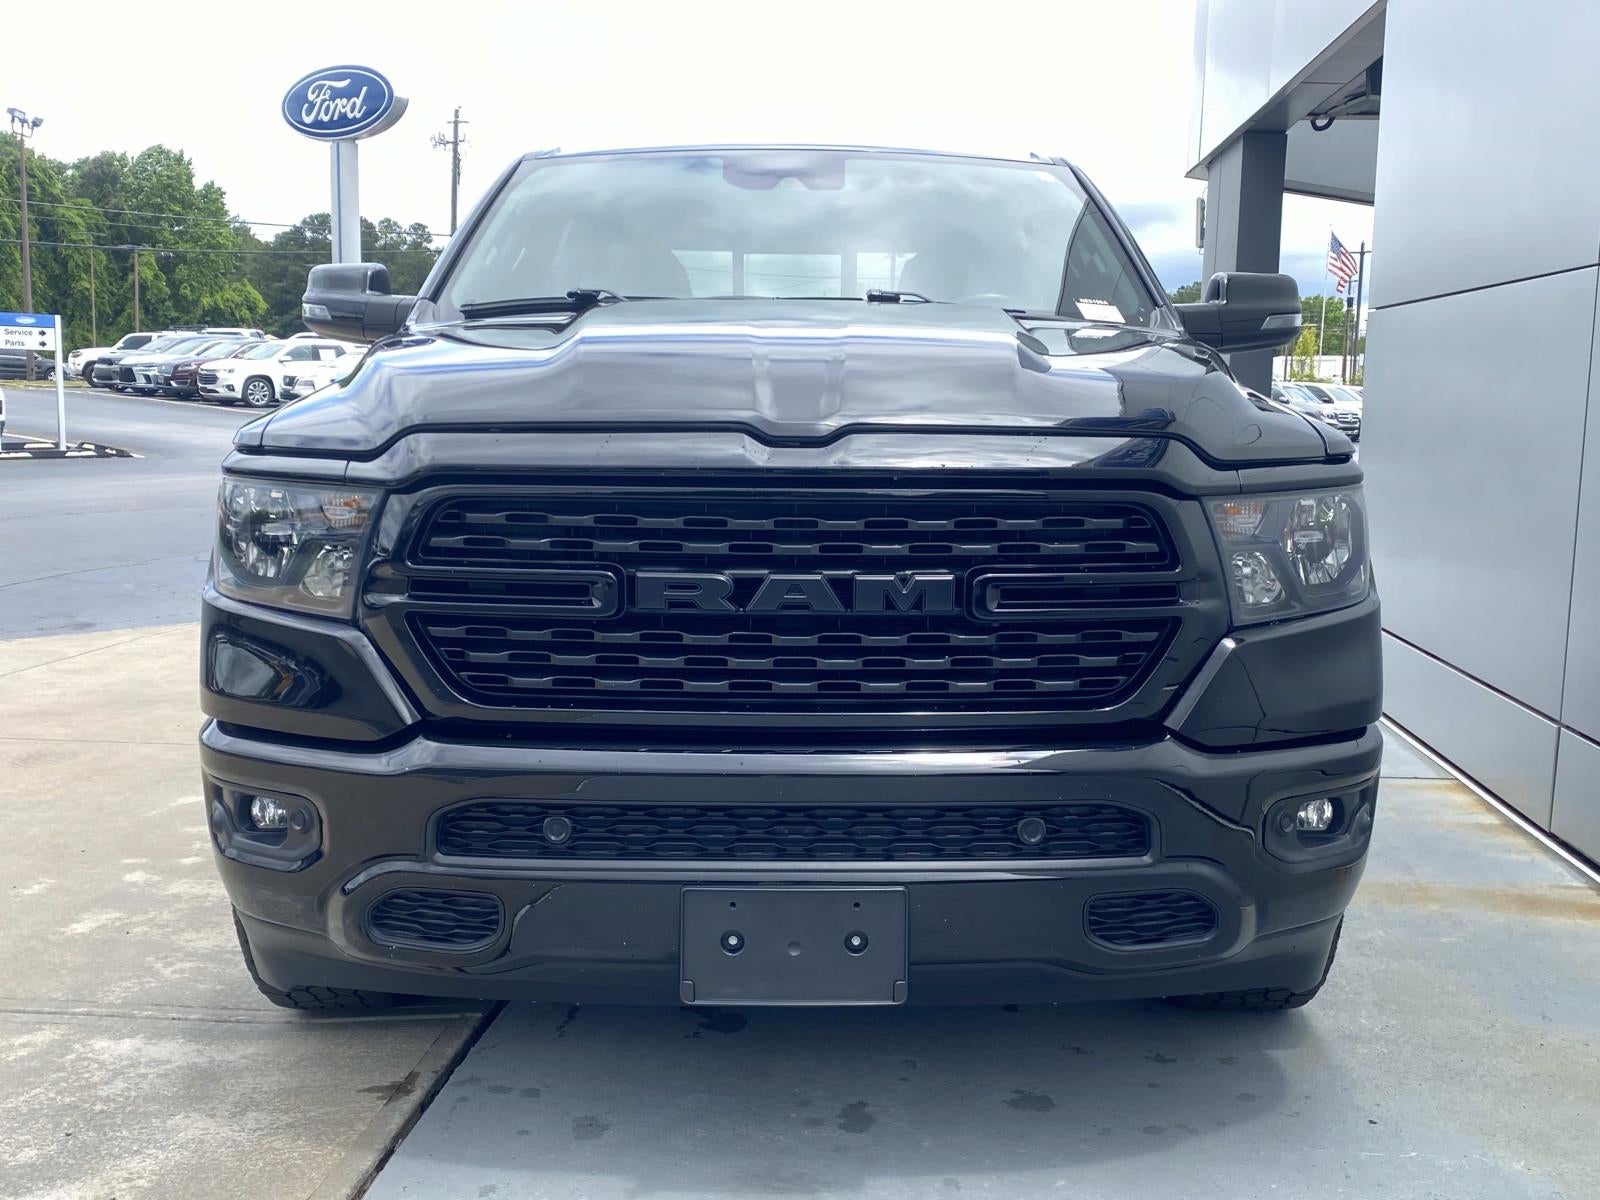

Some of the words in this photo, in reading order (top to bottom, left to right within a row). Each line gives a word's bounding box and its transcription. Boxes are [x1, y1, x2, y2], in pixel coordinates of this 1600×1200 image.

[301, 79, 367, 124] Ford
[4, 328, 33, 336] Service
[636, 572, 955, 612] RAM
